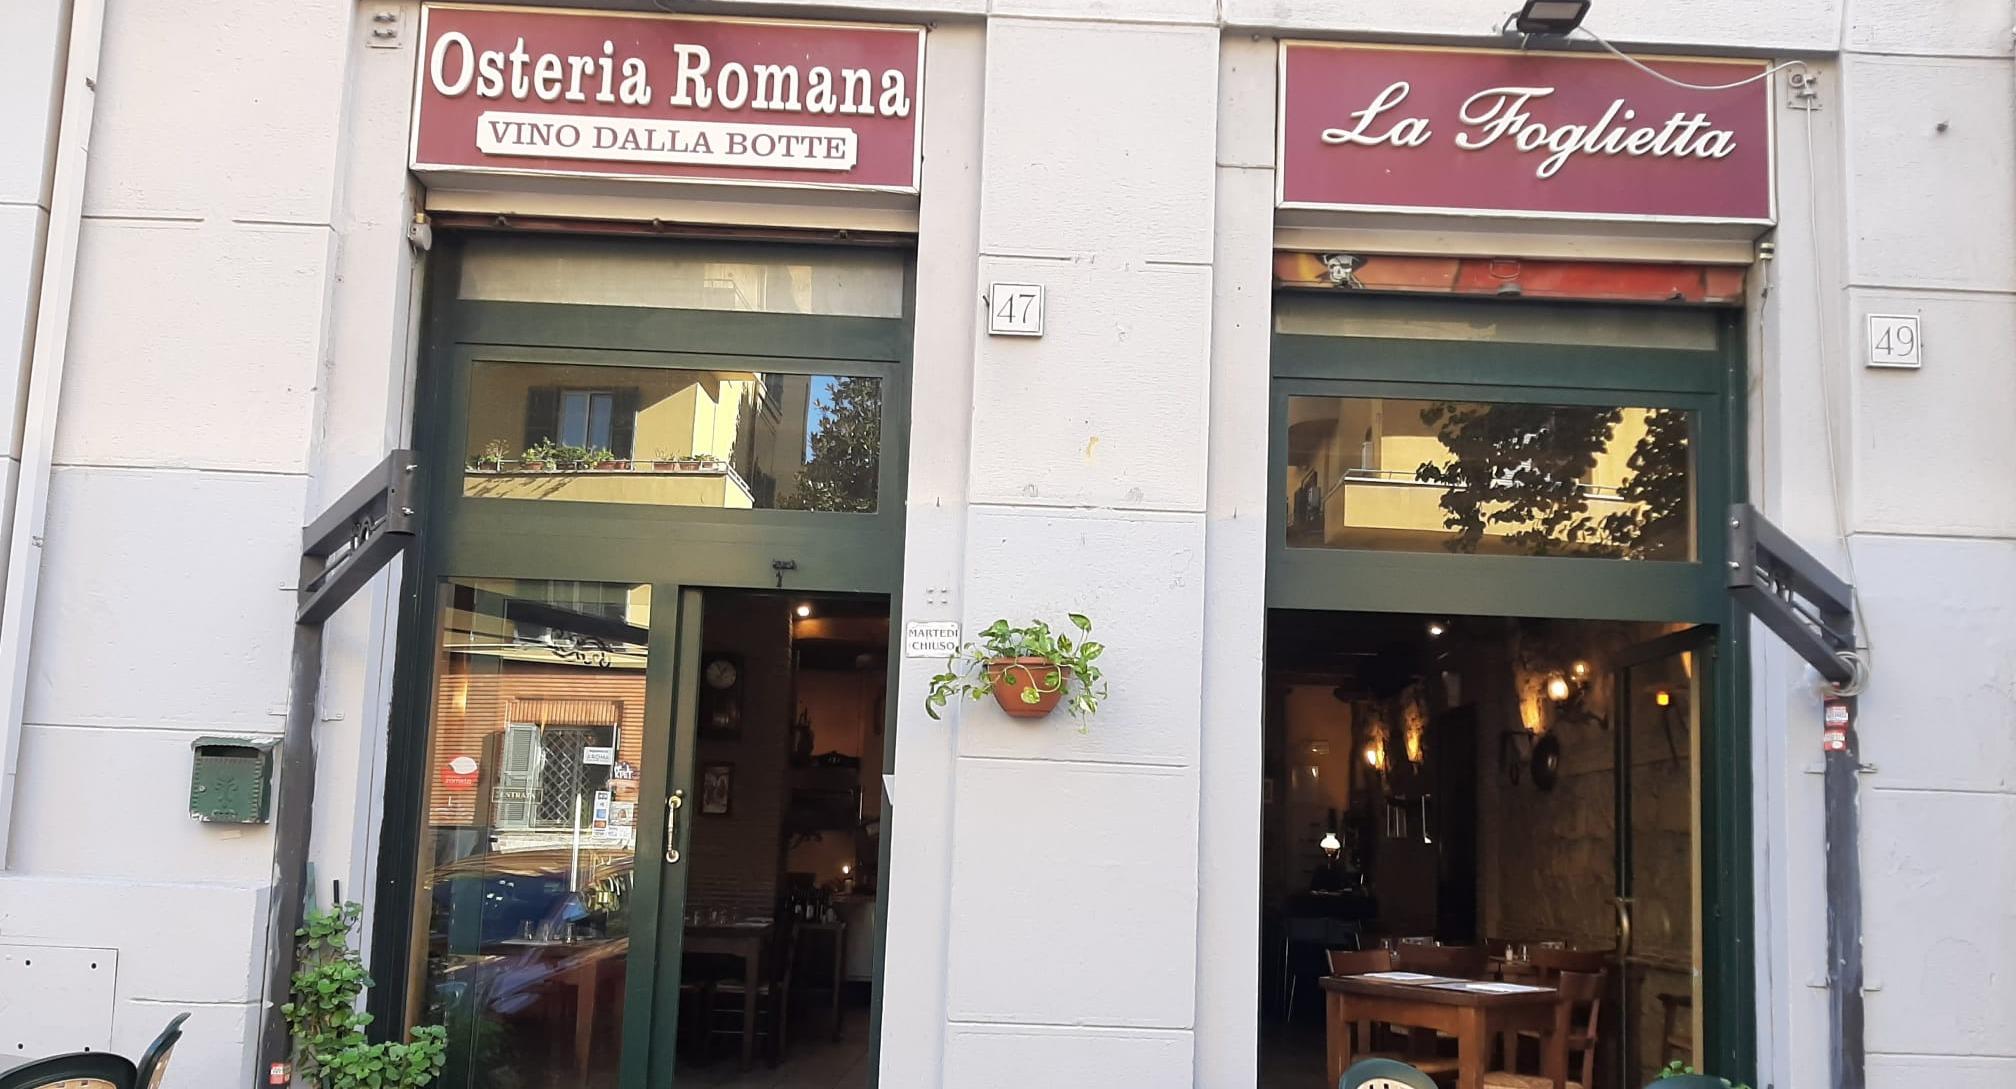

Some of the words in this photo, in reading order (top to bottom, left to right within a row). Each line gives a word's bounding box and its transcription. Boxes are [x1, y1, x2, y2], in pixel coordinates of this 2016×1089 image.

[430, 31, 652, 106] Osteria
[669, 44, 910, 117] Romana
[489, 121, 581, 147] VINO
[592, 126, 714, 154] DALLA
[725, 132, 847, 160] BOTTE
[1321, 81, 1432, 147] La
[1455, 87, 1737, 179] Foglietta
[996, 293, 1037, 324] 47
[1874, 325, 1915, 357] 49
[912, 641, 955, 650] CHIUSO
